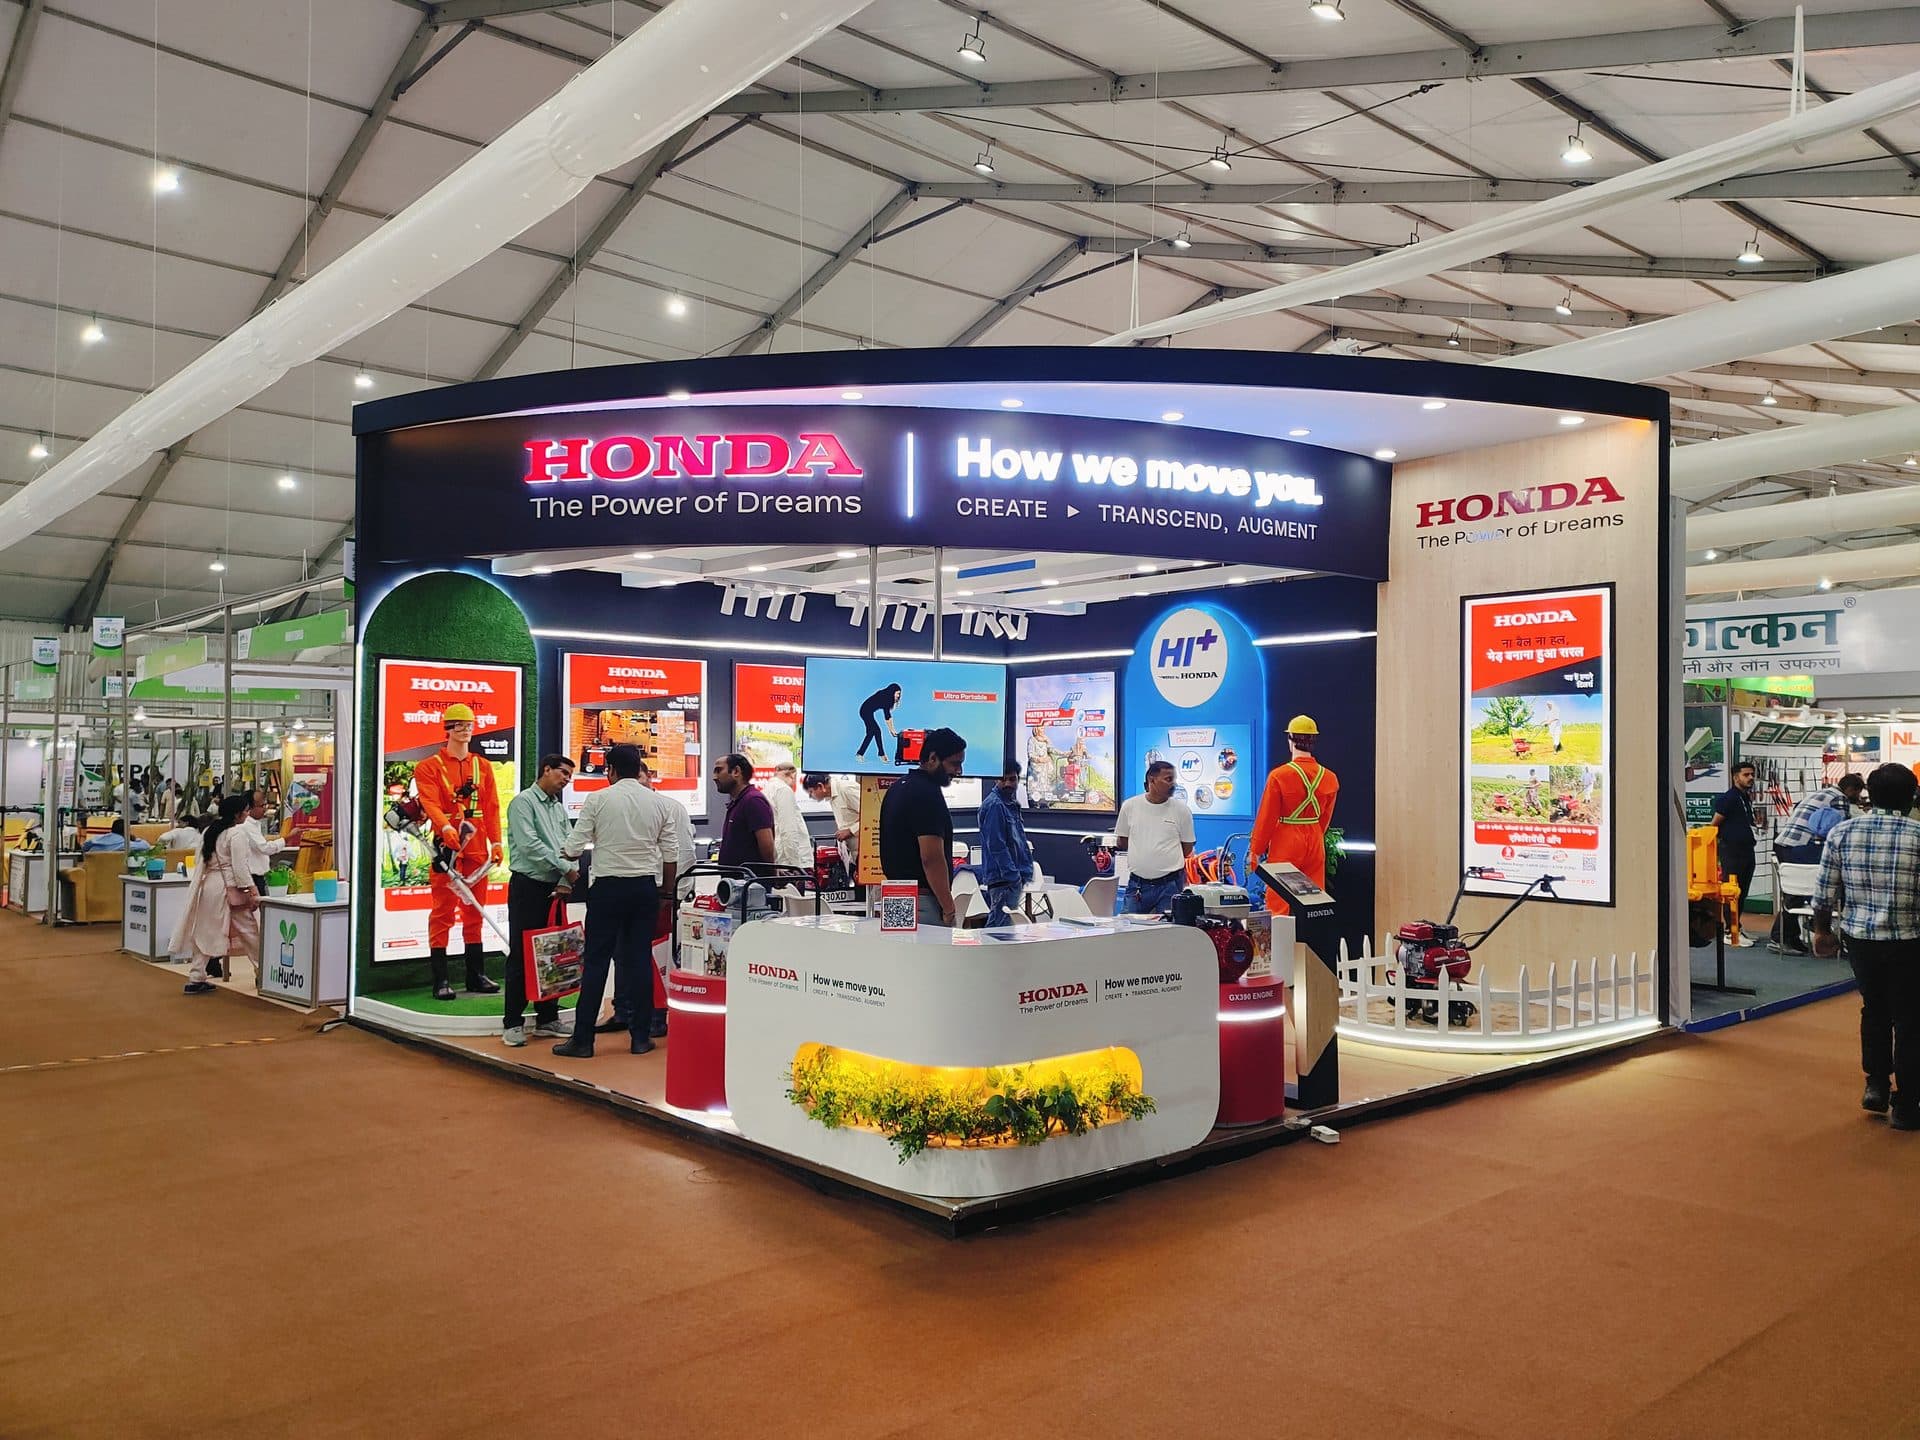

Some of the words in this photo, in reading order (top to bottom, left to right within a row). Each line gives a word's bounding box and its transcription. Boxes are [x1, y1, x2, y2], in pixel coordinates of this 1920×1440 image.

[524, 432, 864, 484] HONDA
[957, 437, 1063, 481] How
[1072, 453, 1139, 487] we
[1146, 459, 1252, 496] move
[1254, 471, 1323, 507] you.
[529, 496, 583, 519] The
[591, 494, 687, 516] Power
[694, 491, 728, 513] of
[737, 491, 862, 514] Dreams
[1416, 476, 1625, 529] HONDA
[956, 497, 1048, 518] CREATE
[1098, 503, 1229, 534] TRANSCEND,
[1237, 516, 1318, 541] AUGMENT
[1416, 534, 1450, 550] The
[1454, 526, 1513, 545] Power
[1517, 521, 1538, 537] of
[1544, 513, 1624, 534] Dreams
[1493, 609, 1577, 628] HONDA
[1685, 608, 1845, 651] ाल्कन
[1501, 639, 1512, 649] ना
[1536, 636, 1546, 646] ना
[608, 667, 667, 679] HONDA
[1707, 658, 1733, 673] और
[1741, 658, 1769, 672] लॉन
[1779, 657, 1841, 671] उपकरण
[772, 675, 804, 686] HON
[1180, 671, 1218, 680] HONDA
[410, 678, 494, 693] HONDA
[943, 692, 960, 700] Ultra
[960, 693, 988, 701] Portable
[1307, 908, 1335, 918] HONDA
[270, 965, 304, 989] InHydro
[748, 963, 799, 982] HONDA
[812, 973, 830, 986] How
[831, 978, 844, 988] we
[845, 981, 867, 993] move
[868, 986, 886, 997] you.
[758, 978, 773, 987] Power
[779, 981, 800, 991] Dreams
[1018, 982, 1088, 1005] HONDA
[1104, 978, 1125, 990] How
[1126, 977, 1140, 987] we
[1141, 975, 1164, 985] move
[1165, 972, 1183, 985] you.
[1104, 993, 1122, 1001] CREATE
[1161, 985, 1182, 993] AUGMENT
[1252, 990, 1274, 1000] ENGINE
[812, 988, 828, 997] CREATE
[864, 998, 886, 1008] AUGMENT
[1019, 1006, 1033, 1015] The
[1034, 1003, 1055, 1012] Power
[1056, 1001, 1064, 1009] of
[1064, 997, 1089, 1007] Dreams
